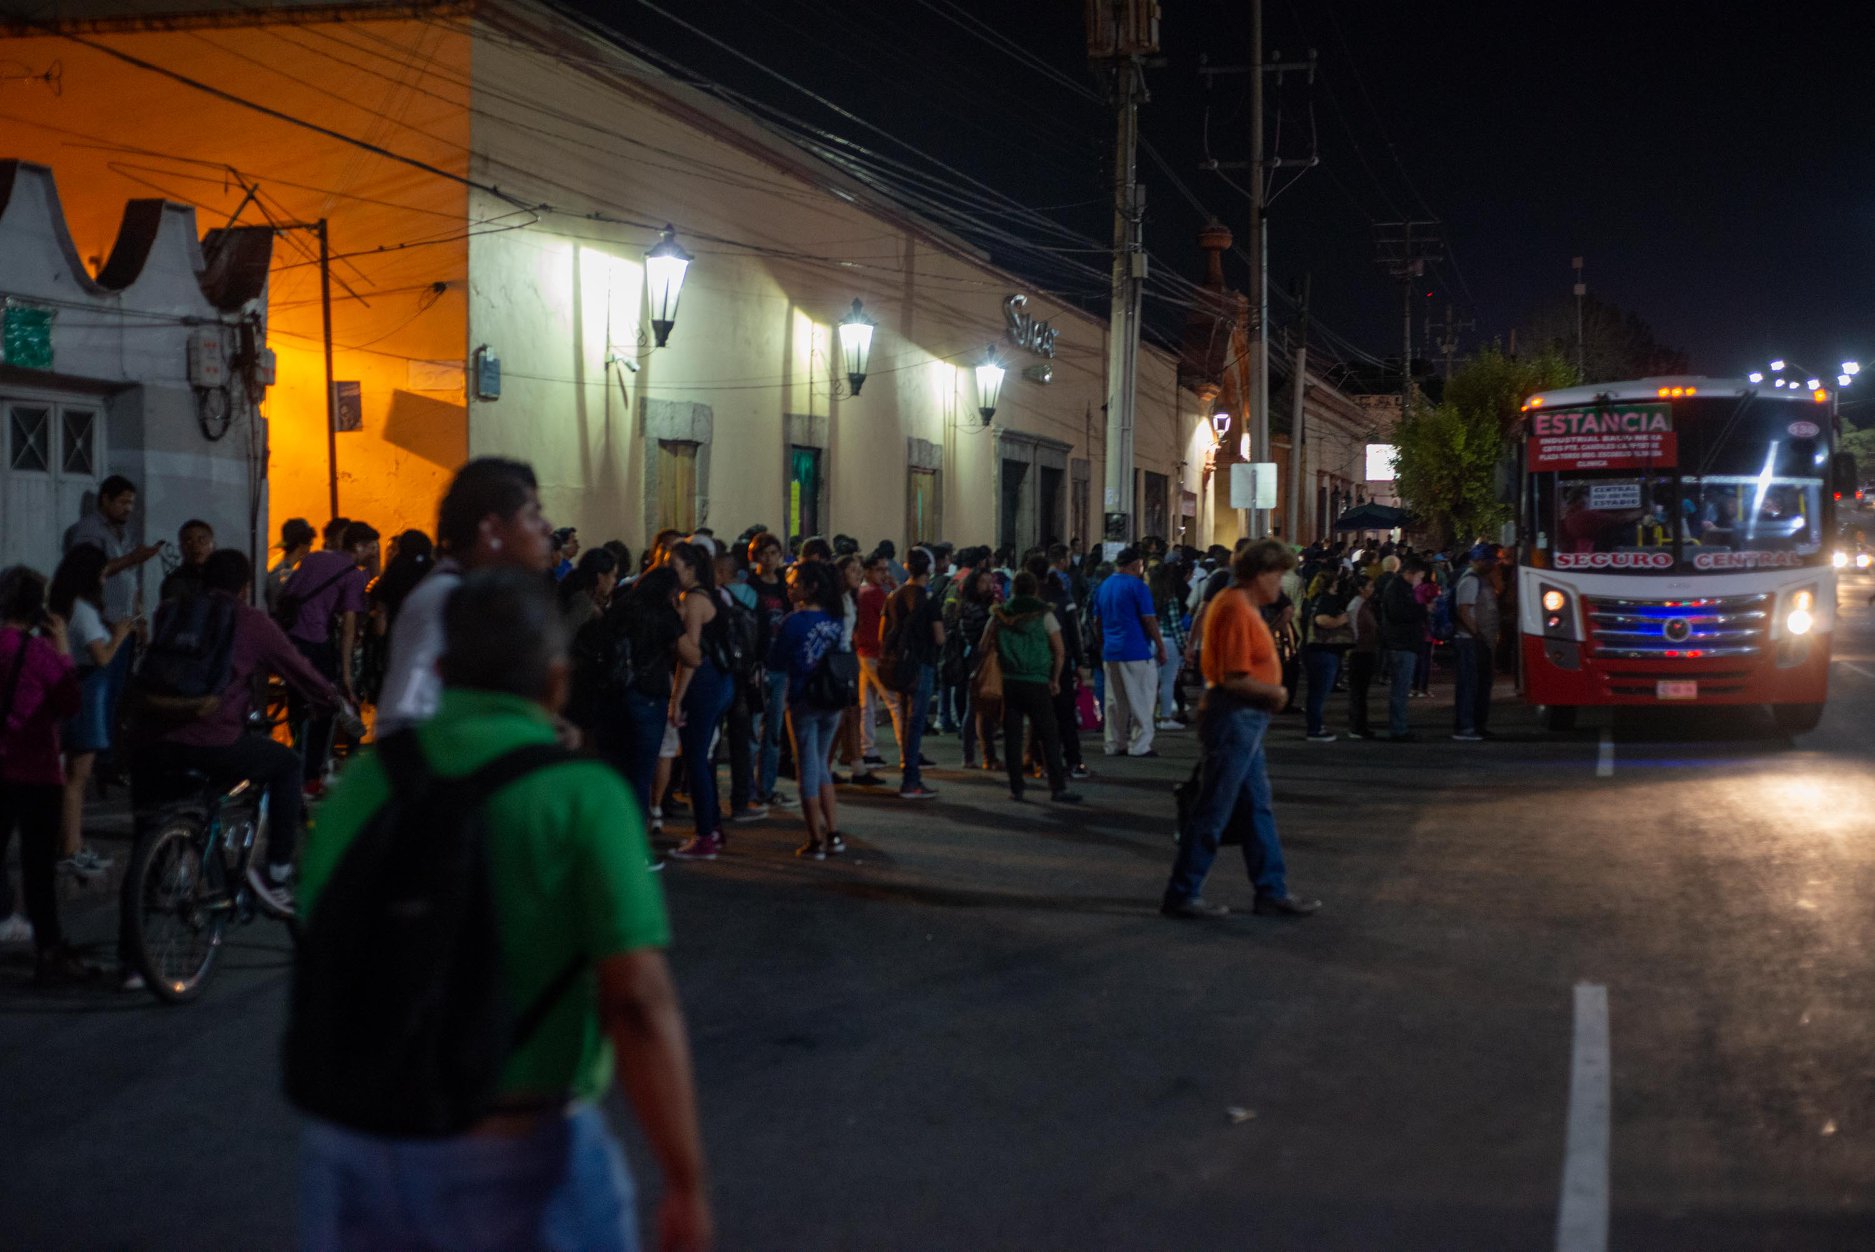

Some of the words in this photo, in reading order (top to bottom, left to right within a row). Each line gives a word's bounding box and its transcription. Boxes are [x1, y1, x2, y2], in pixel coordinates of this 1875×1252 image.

[1535, 412, 1667, 435] ESTANCIA
[1539, 435, 1600, 445] INDUSTRIAL
[1556, 552, 1674, 569] SEGURO
[1694, 550, 1803, 569] CENTRAL
